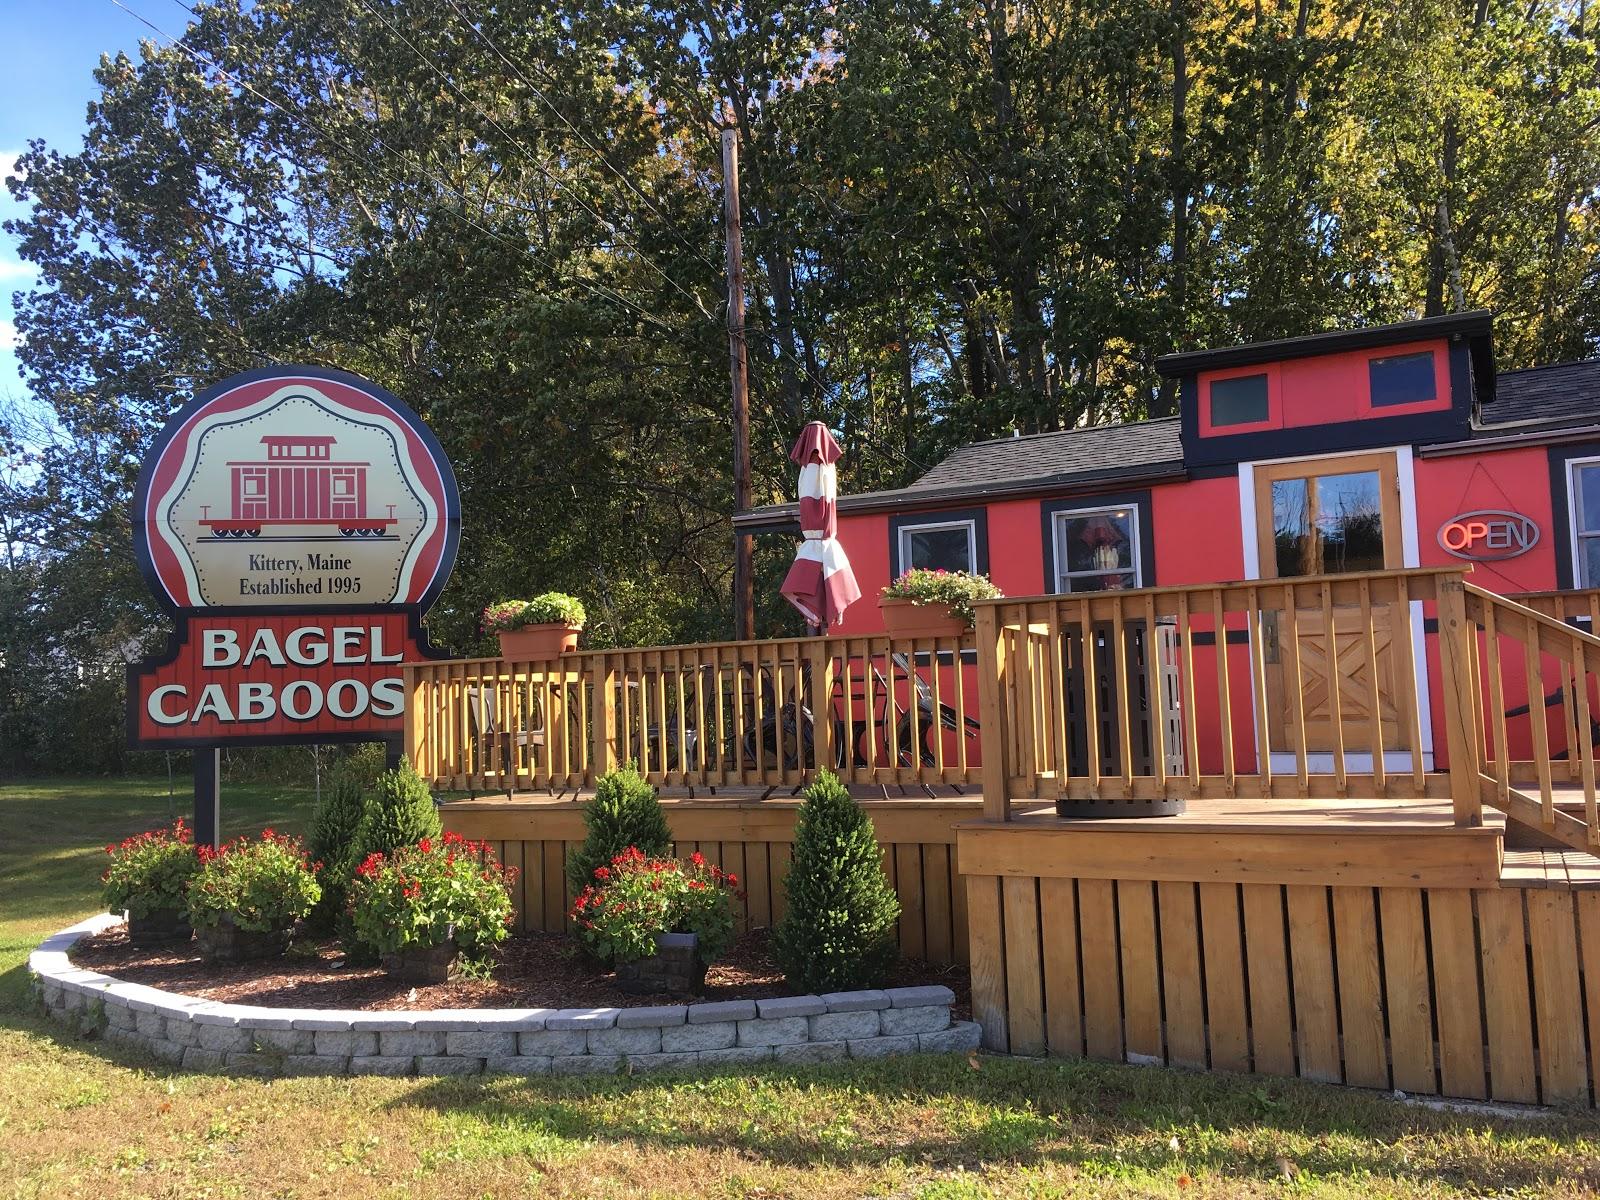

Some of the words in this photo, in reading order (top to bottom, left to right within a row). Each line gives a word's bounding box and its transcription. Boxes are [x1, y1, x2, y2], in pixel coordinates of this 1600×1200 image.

[1443, 520, 1527, 550] OPEN
[249, 553, 303, 576] Kittery,
[307, 553, 352, 571] Maine
[239, 577, 323, 596] Established
[327, 577, 362, 594] 1995
[202, 626, 404, 669] BAGEL
